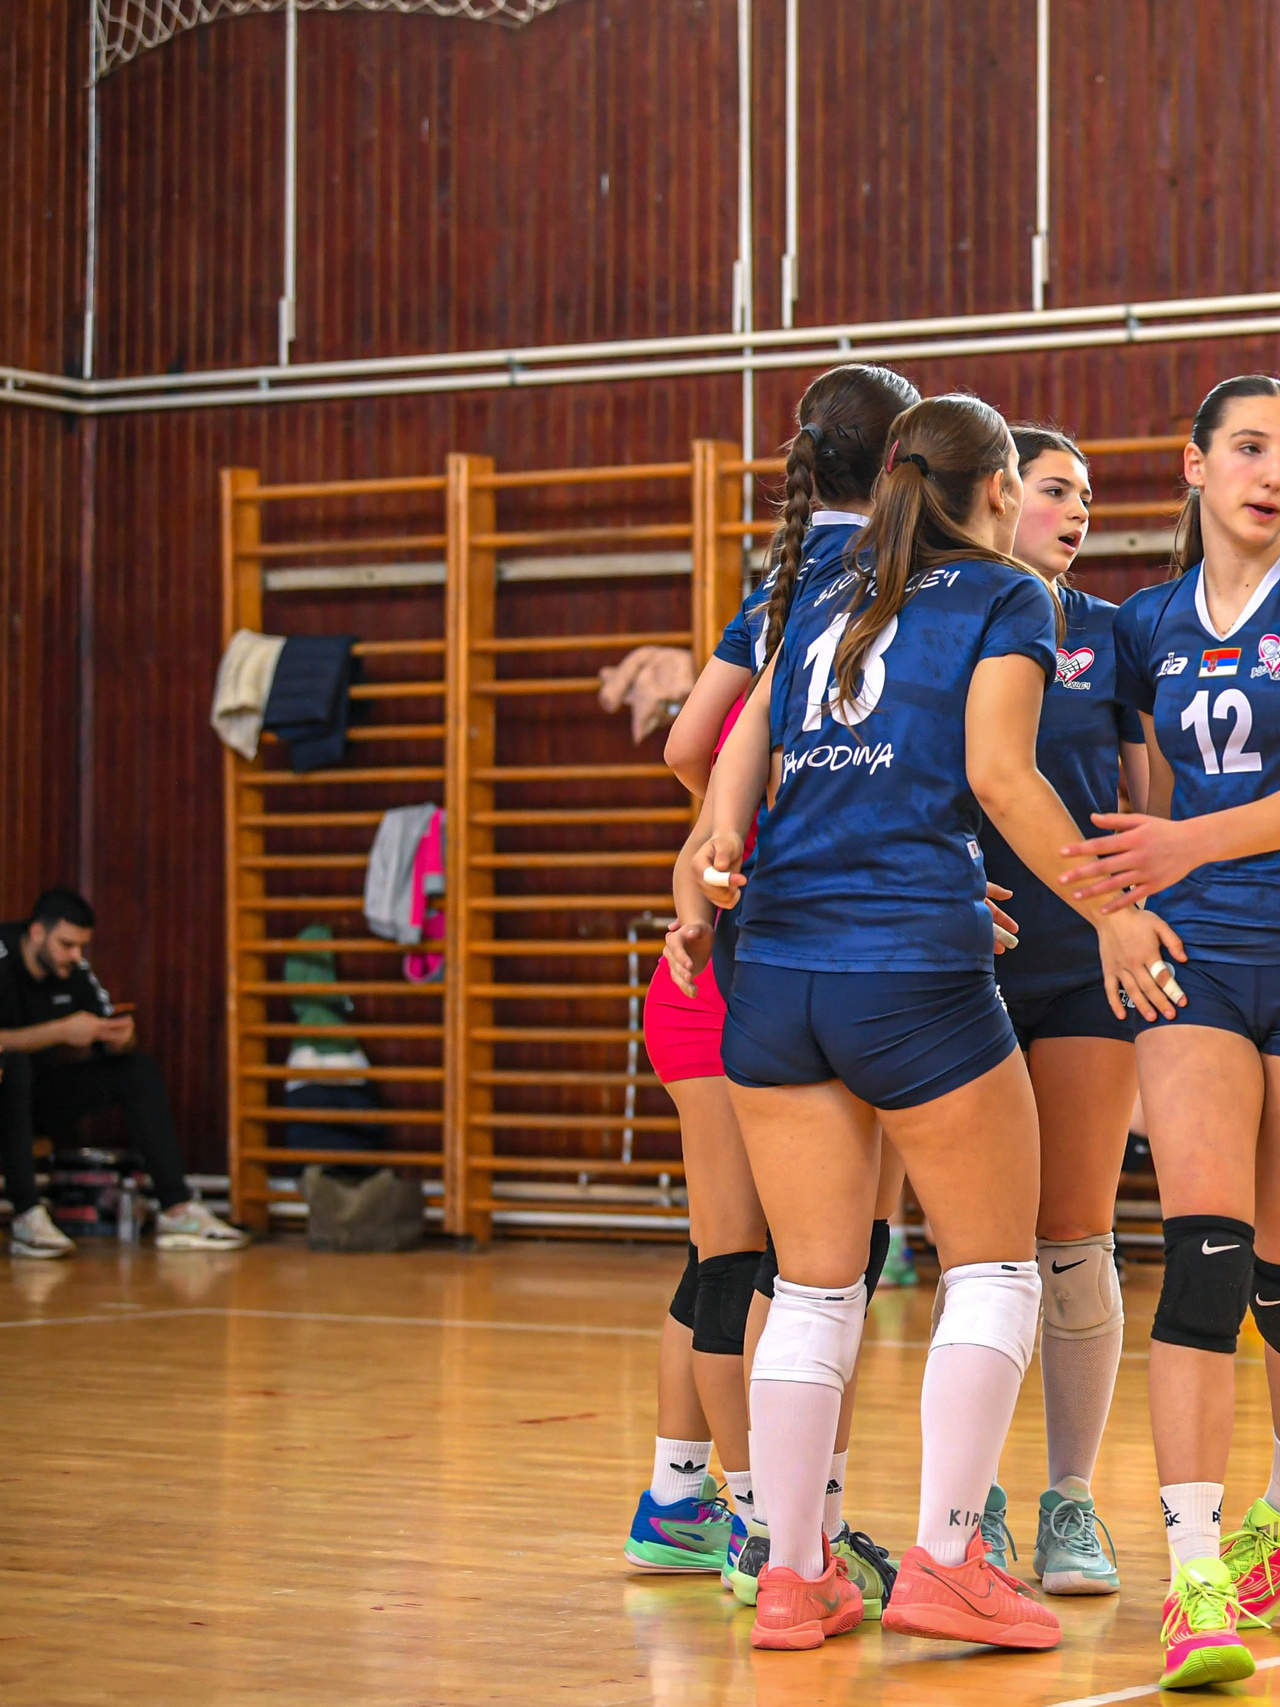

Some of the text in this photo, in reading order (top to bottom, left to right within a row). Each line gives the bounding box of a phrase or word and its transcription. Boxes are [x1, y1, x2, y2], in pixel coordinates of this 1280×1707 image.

[801, 612, 899, 732] 13
[1180, 688, 1263, 775] 12
[949, 1508, 983, 1527] KIP
